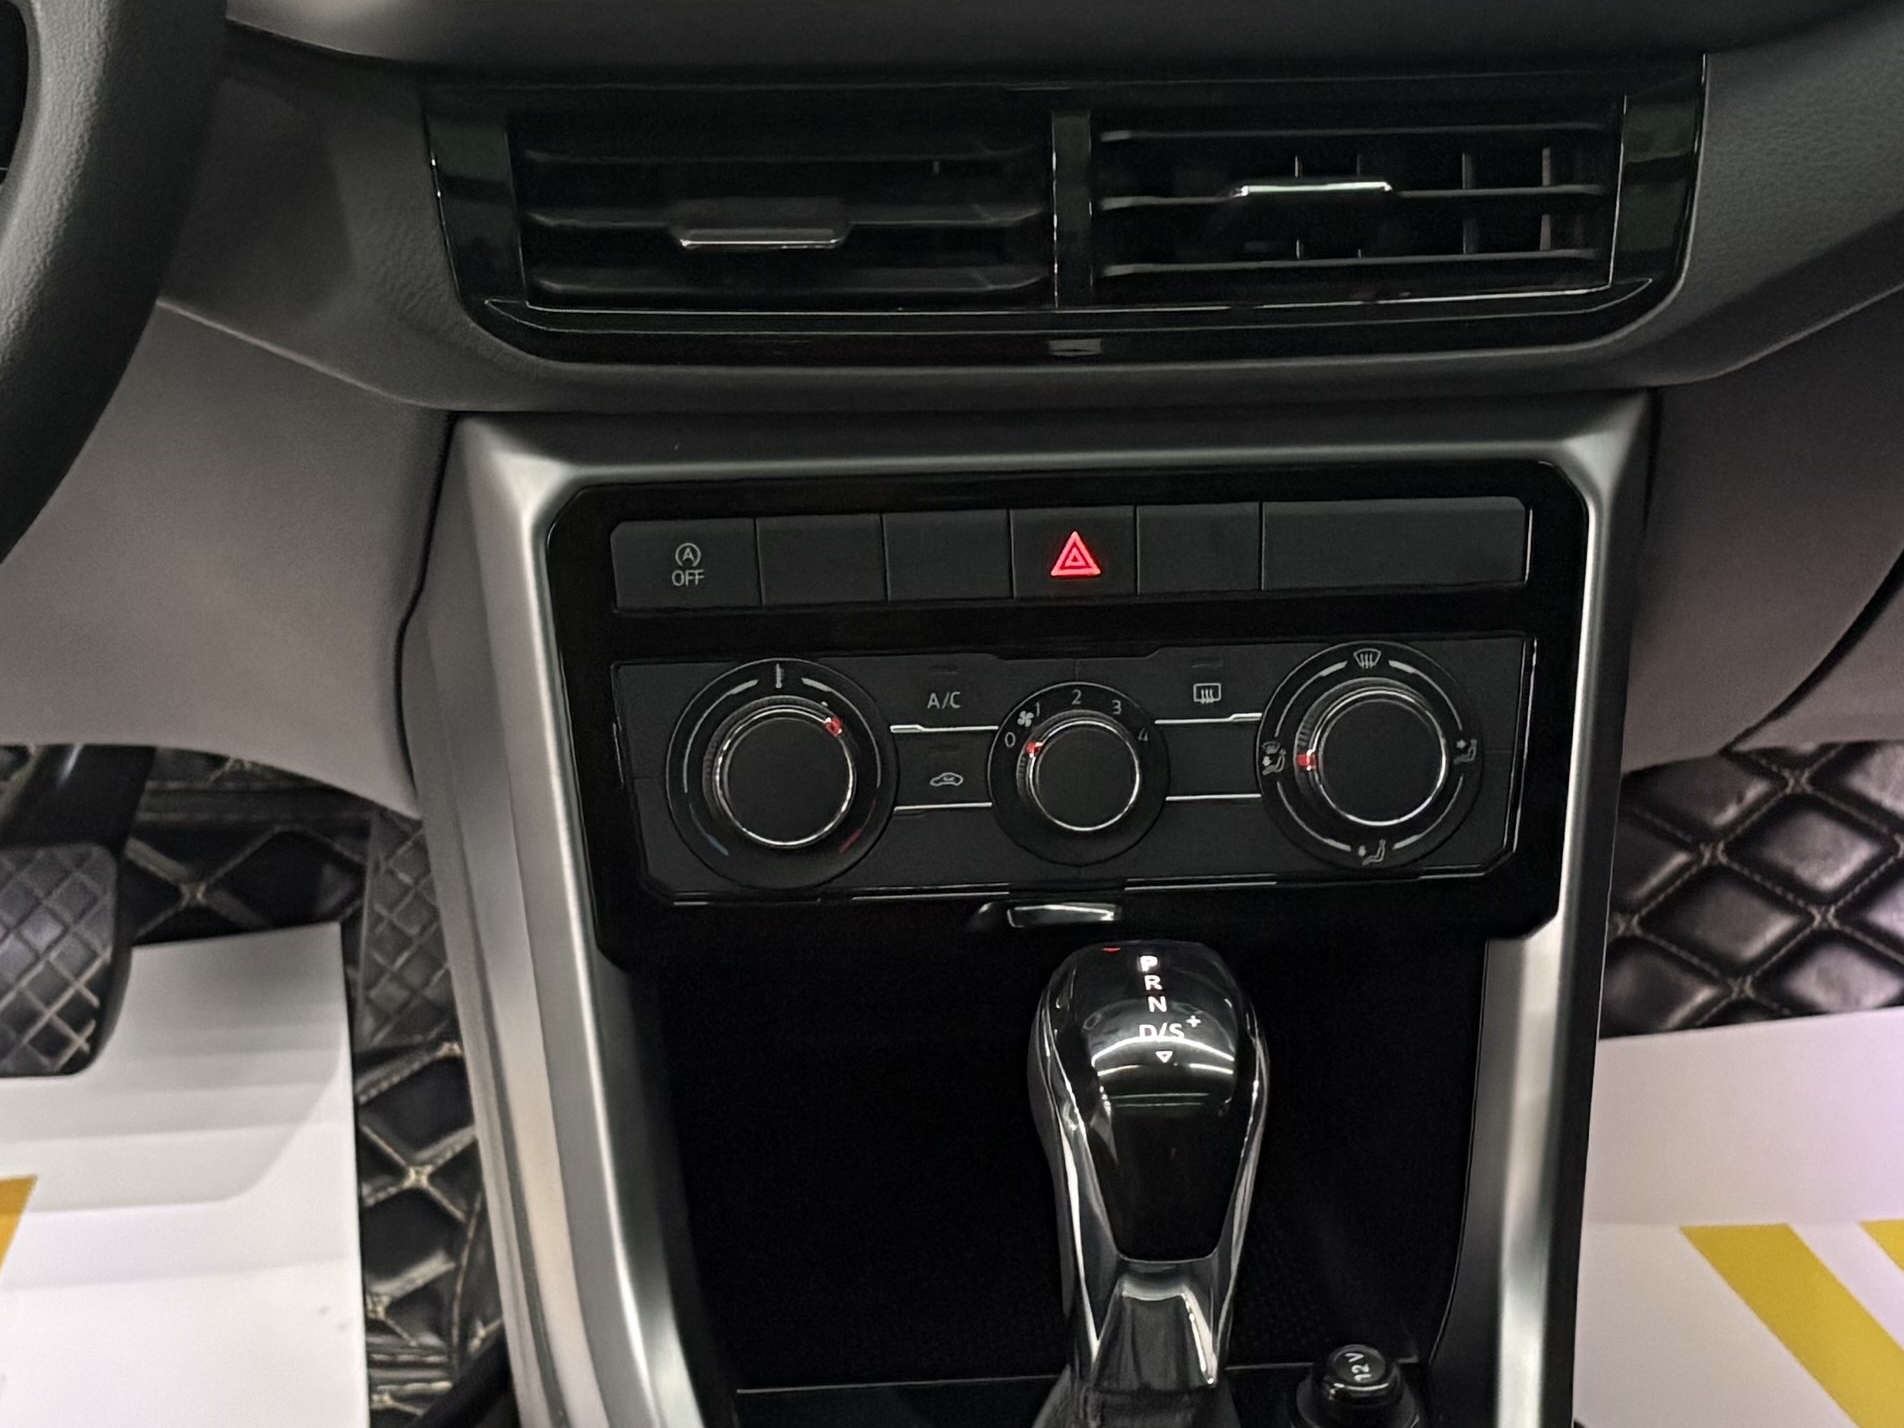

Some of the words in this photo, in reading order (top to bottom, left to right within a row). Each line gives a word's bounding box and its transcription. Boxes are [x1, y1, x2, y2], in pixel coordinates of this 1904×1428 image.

[671, 568, 705, 588] OFF
[927, 691, 962, 710] A/C
[1071, 688, 1083, 705] 2
[1033, 702, 1041, 718] 1
[1111, 699, 1123, 715] 3
[1004, 731, 1016, 749] 0
[1137, 728, 1149, 743] 4
[1140, 955, 1158, 972] P
[1144, 975, 1163, 991] R
[1148, 995, 1167, 1013] N
